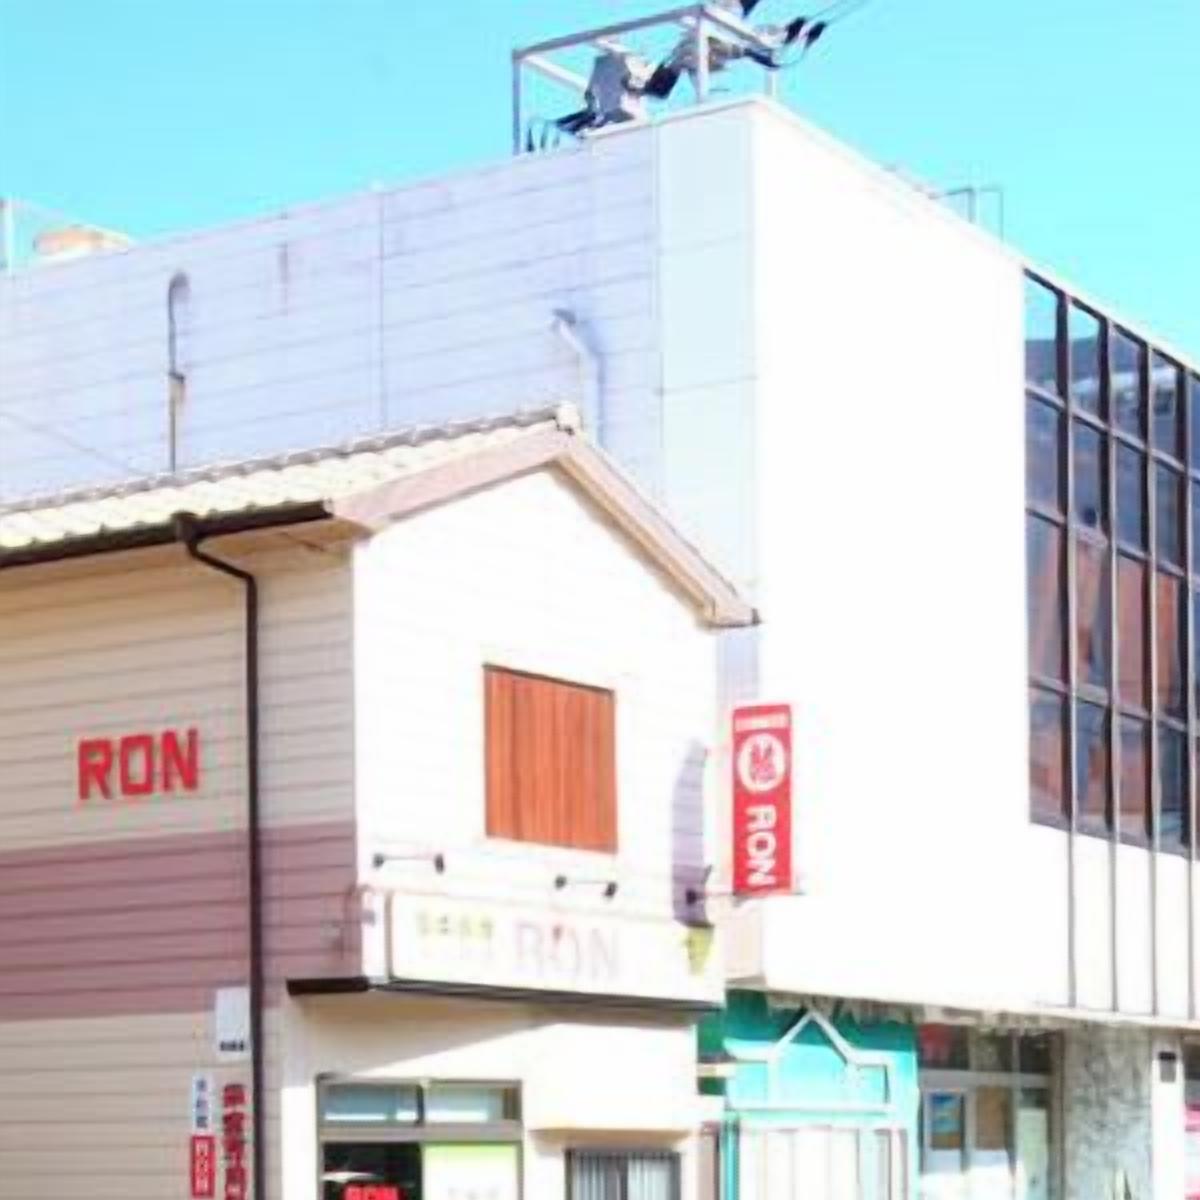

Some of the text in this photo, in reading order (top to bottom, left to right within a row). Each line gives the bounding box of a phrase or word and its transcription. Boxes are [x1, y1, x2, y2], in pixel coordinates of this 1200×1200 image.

[79, 728, 198, 800] RON
[746, 804, 777, 887] RON
[515, 919, 618, 978] RON
